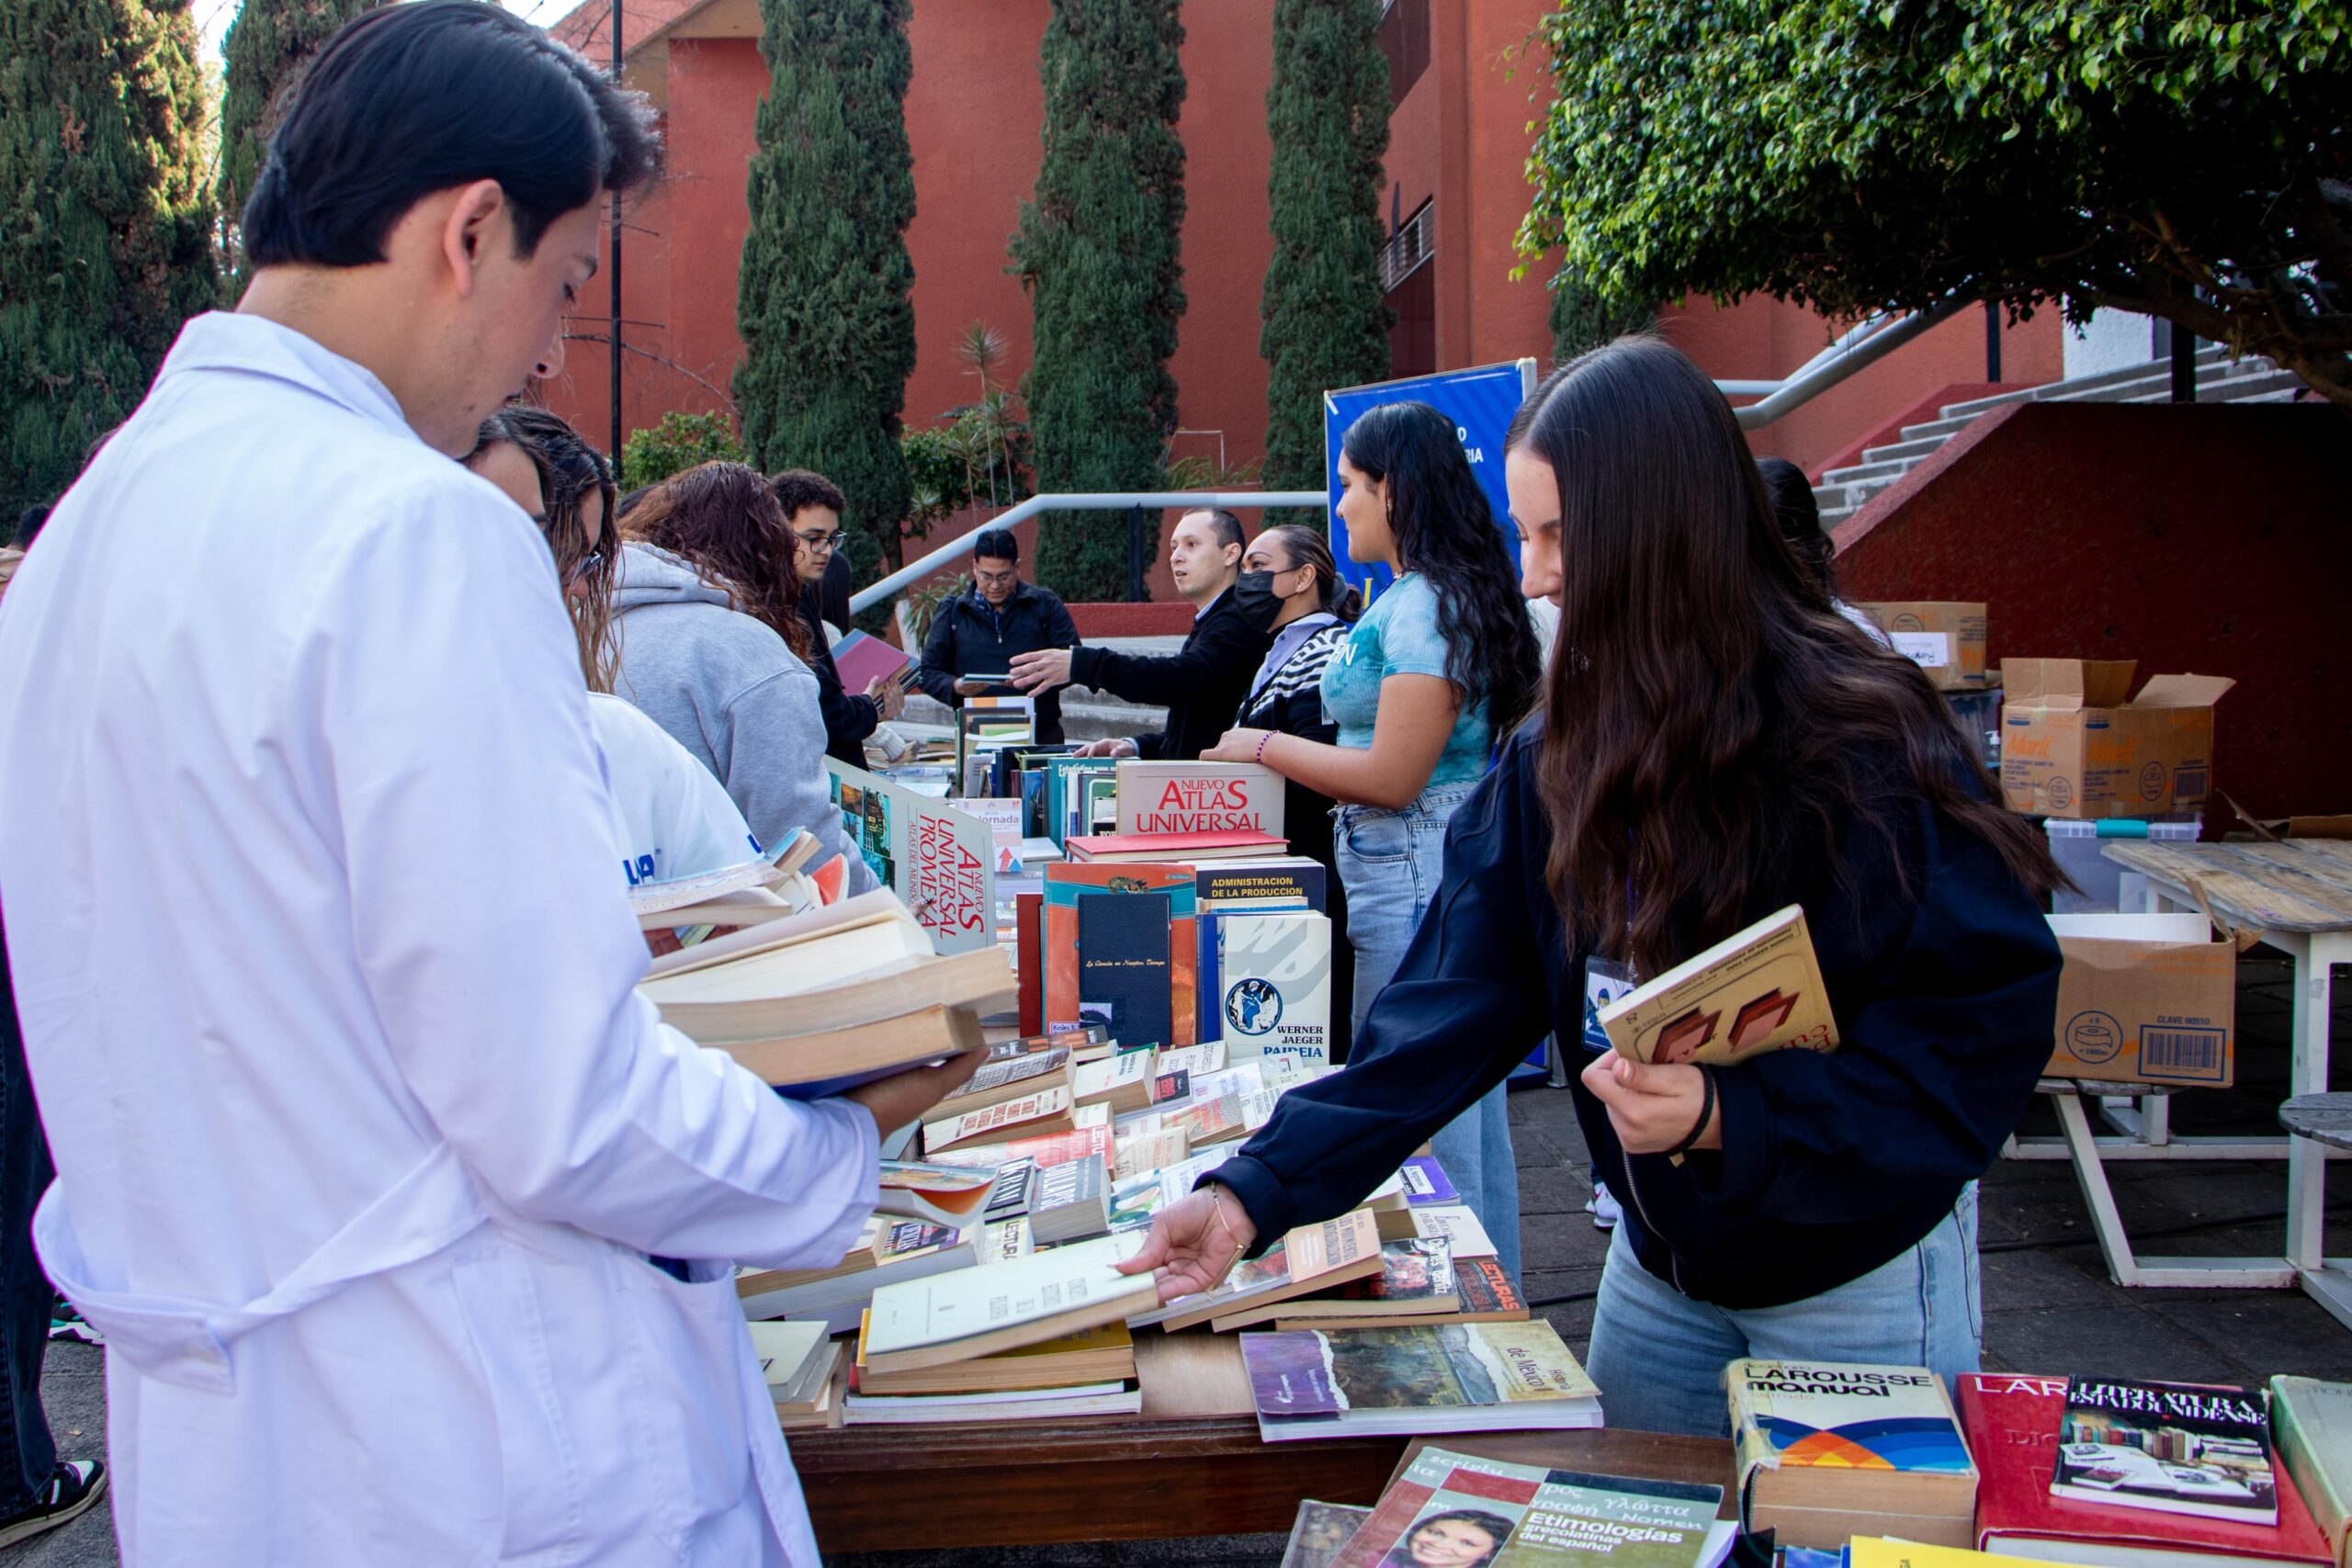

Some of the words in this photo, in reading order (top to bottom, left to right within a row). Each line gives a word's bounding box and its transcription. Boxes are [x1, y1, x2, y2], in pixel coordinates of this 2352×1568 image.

[1182, 780, 1225, 790] NUEVO
[1158, 780, 1248, 810] ATLAS
[978, 815, 1019, 825] Jornada
[1136, 812, 1266, 832] UNIVERSAL
[938, 818, 956, 941] UNIVERSAL
[956, 844, 984, 933] ATLAS
[1212, 877, 1294, 887] ADMINISTRACION
[975, 872, 985, 913] NUEVO
[1212, 889, 1224, 897] DE
[1227, 889, 1238, 897] LA
[1241, 887, 1303, 897] PRODUCCION
[1276, 1025, 1323, 1034] WERNER
[2157, 1015, 2184, 1025] CLAVE
[1282, 1035, 1323, 1044] JAEGER
[1507, 1348, 1530, 1359] de
[1514, 1359, 1546, 1387] México
[1746, 1368, 1933, 1387] LAROUSSE
[1747, 1381, 1891, 1397] manual
[2079, 1382, 2256, 1413] LITERATURA
[2070, 1391, 2267, 1425] ESTADOUNIDENSE
[1528, 1511, 1684, 1543] Etimologías
[1621, 1512, 1702, 1530] Nomen
[1519, 1531, 1544, 1542] del
[1547, 1536, 1613, 1552] español
[1523, 1523, 1623, 1545] grecolatinas
